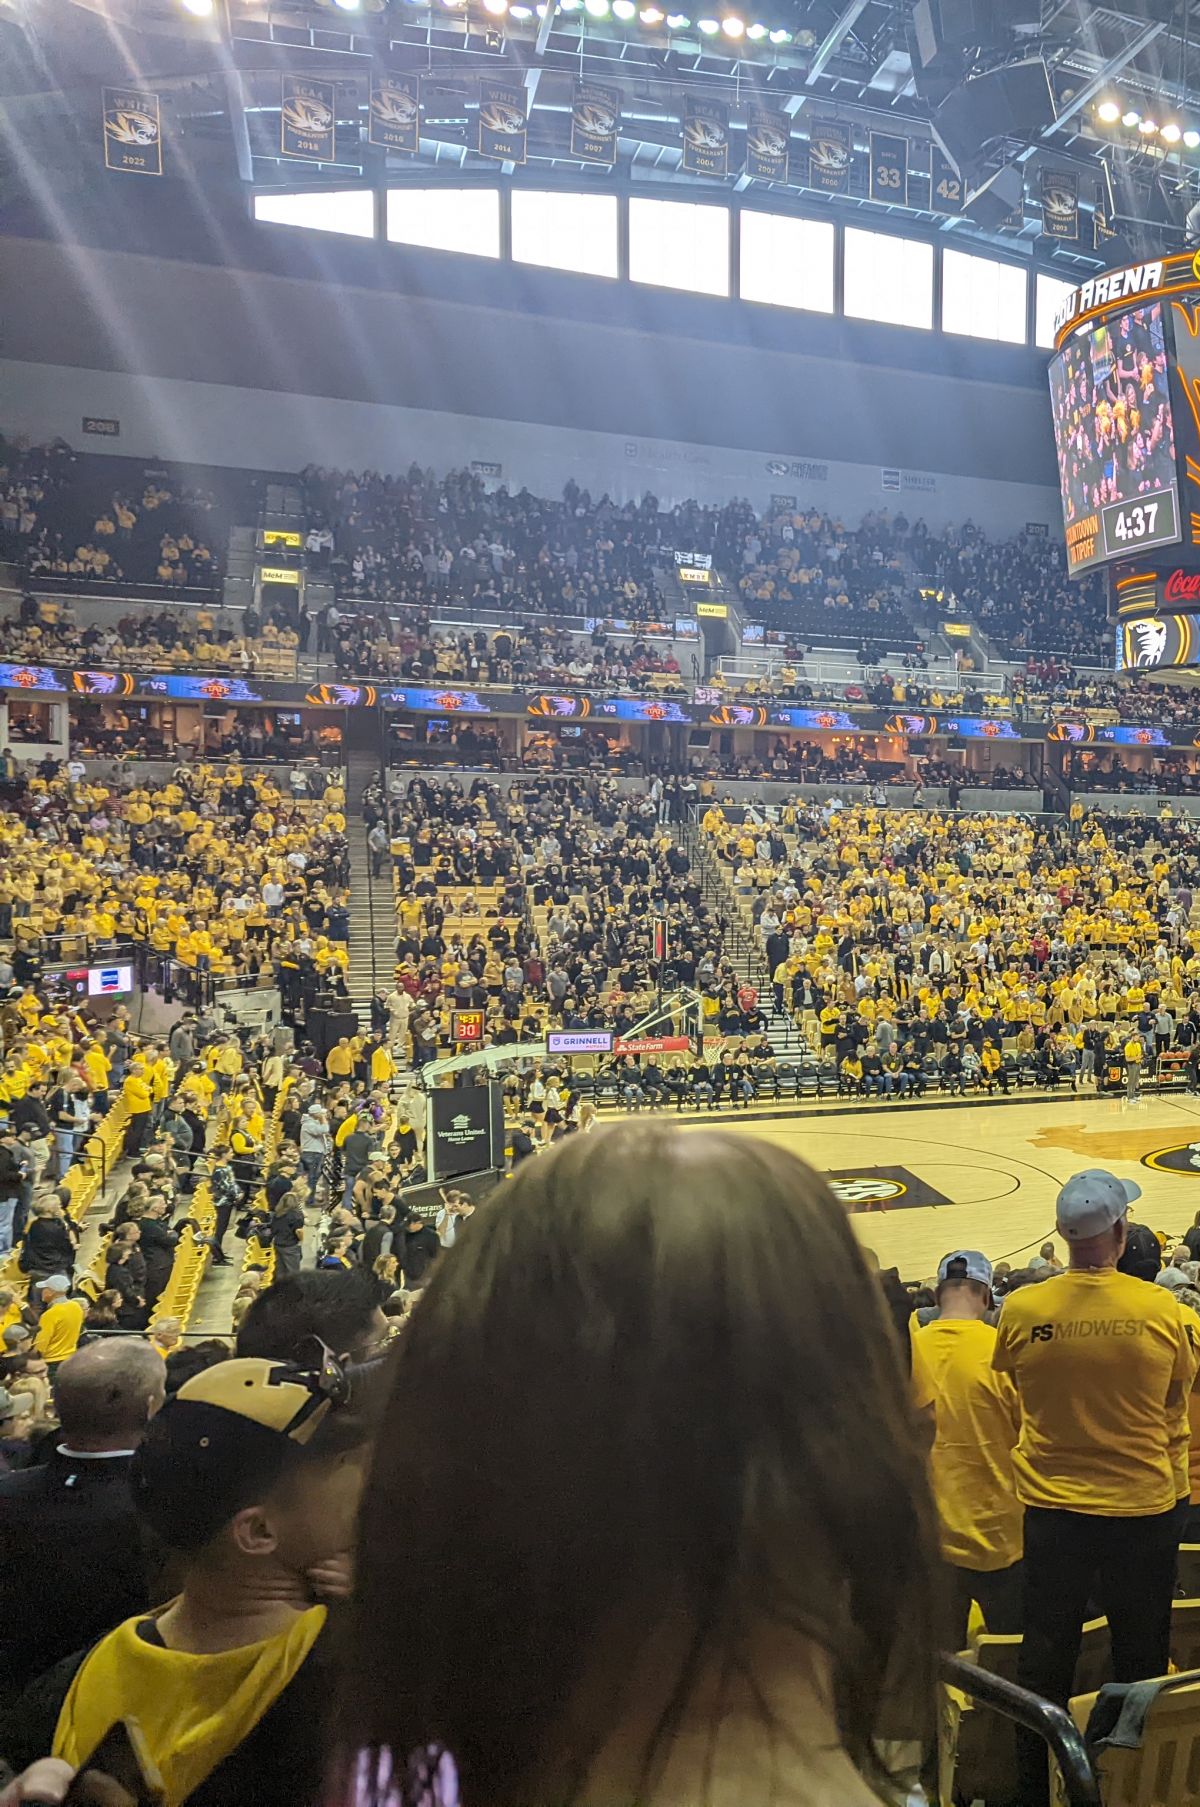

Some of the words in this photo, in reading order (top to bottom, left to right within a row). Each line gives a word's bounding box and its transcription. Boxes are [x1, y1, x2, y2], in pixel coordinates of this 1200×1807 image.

[122, 155, 146, 167] 2022
[876, 165, 901, 188] 33
[936, 179, 960, 201] 42
[1079, 261, 1164, 314] ARENA
[1115, 503, 1159, 541] 4:37
[1066, 514, 1099, 546] COUNTDOWN
[1076, 537, 1095, 563] TIPOFF
[151, 681, 167, 690] VS
[391, 693, 406, 702] VS
[603, 705, 616, 713] VS
[779, 713, 791, 722] VS
[76, 982, 84, 992] 0
[459, 1014, 480, 1024] 4:37
[459, 1024, 476, 1037] 30
[563, 1037, 608, 1045] GRINNELL
